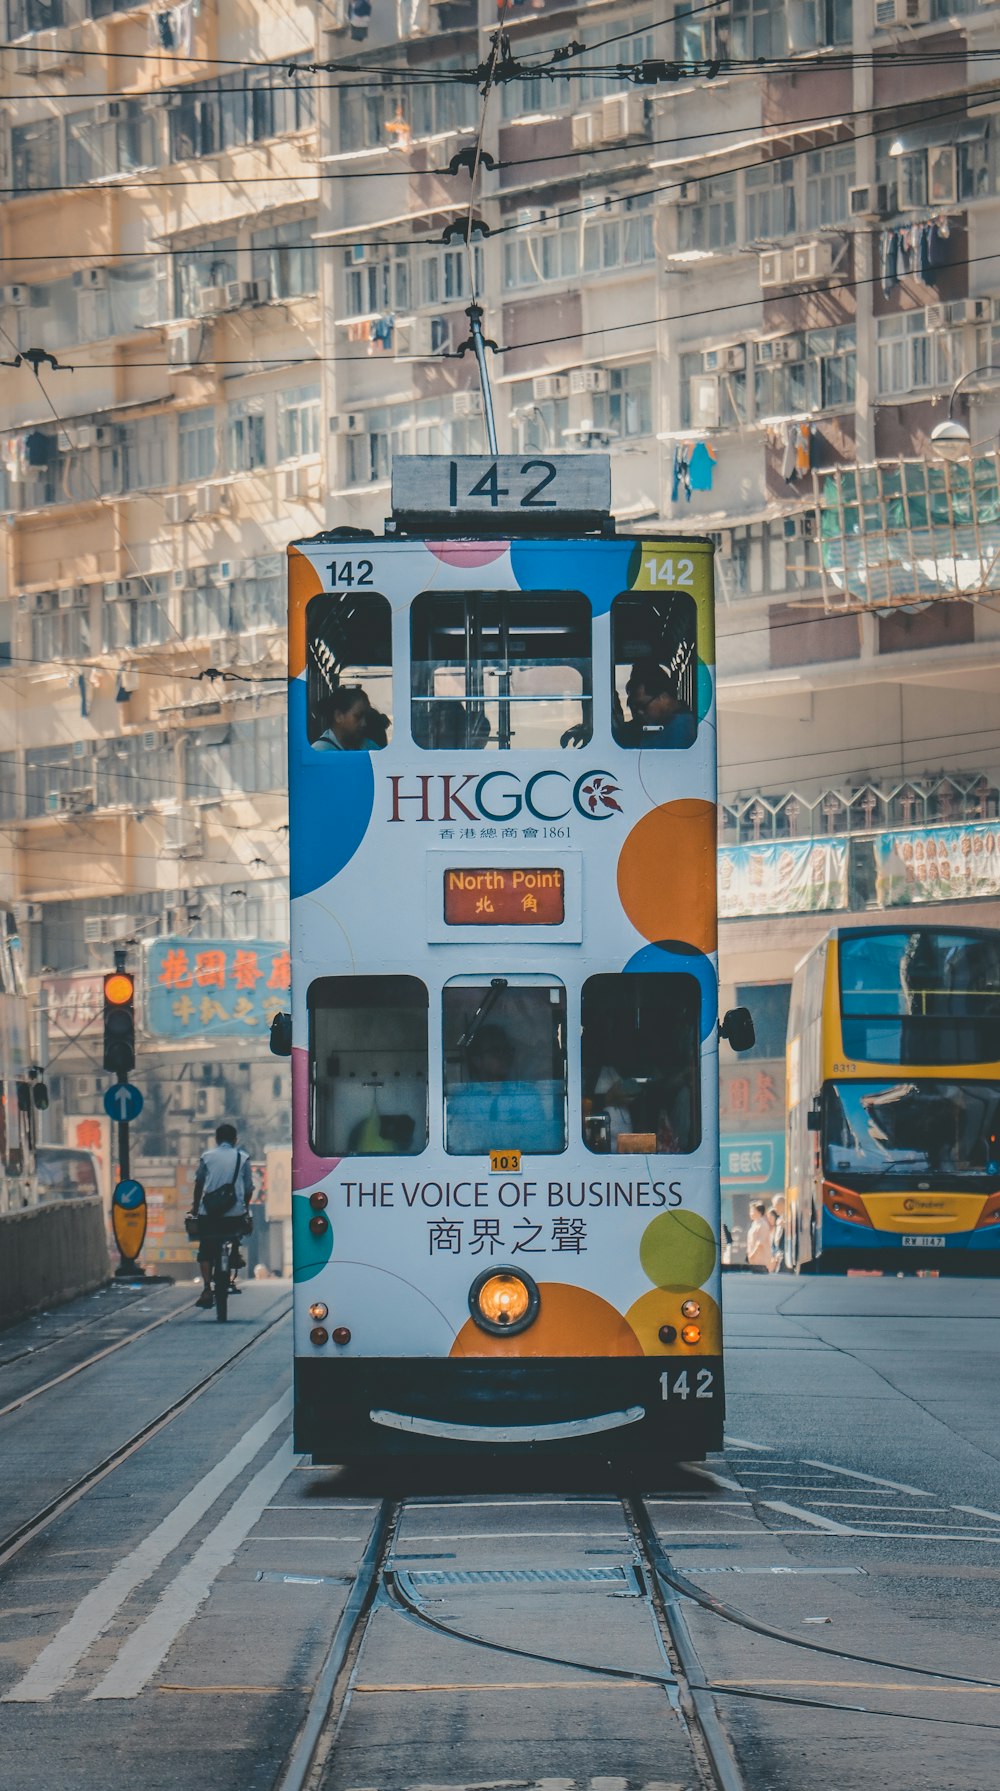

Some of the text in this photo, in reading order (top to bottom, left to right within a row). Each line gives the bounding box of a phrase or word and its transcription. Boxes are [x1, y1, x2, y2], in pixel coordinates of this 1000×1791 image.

[449, 461, 556, 507] 142
[326, 560, 373, 586] 142
[645, 559, 694, 585] 142
[386, 770, 619, 821] HKGCC
[449, 870, 561, 890] North Point
[833, 1064, 857, 1072] 8313
[491, 1156, 519, 1169] 103
[341, 1181, 683, 1208] THE VOICE OF BUSINESS
[427, 1216, 588, 1255] 商界之聲
[659, 1368, 713, 1400] 142
